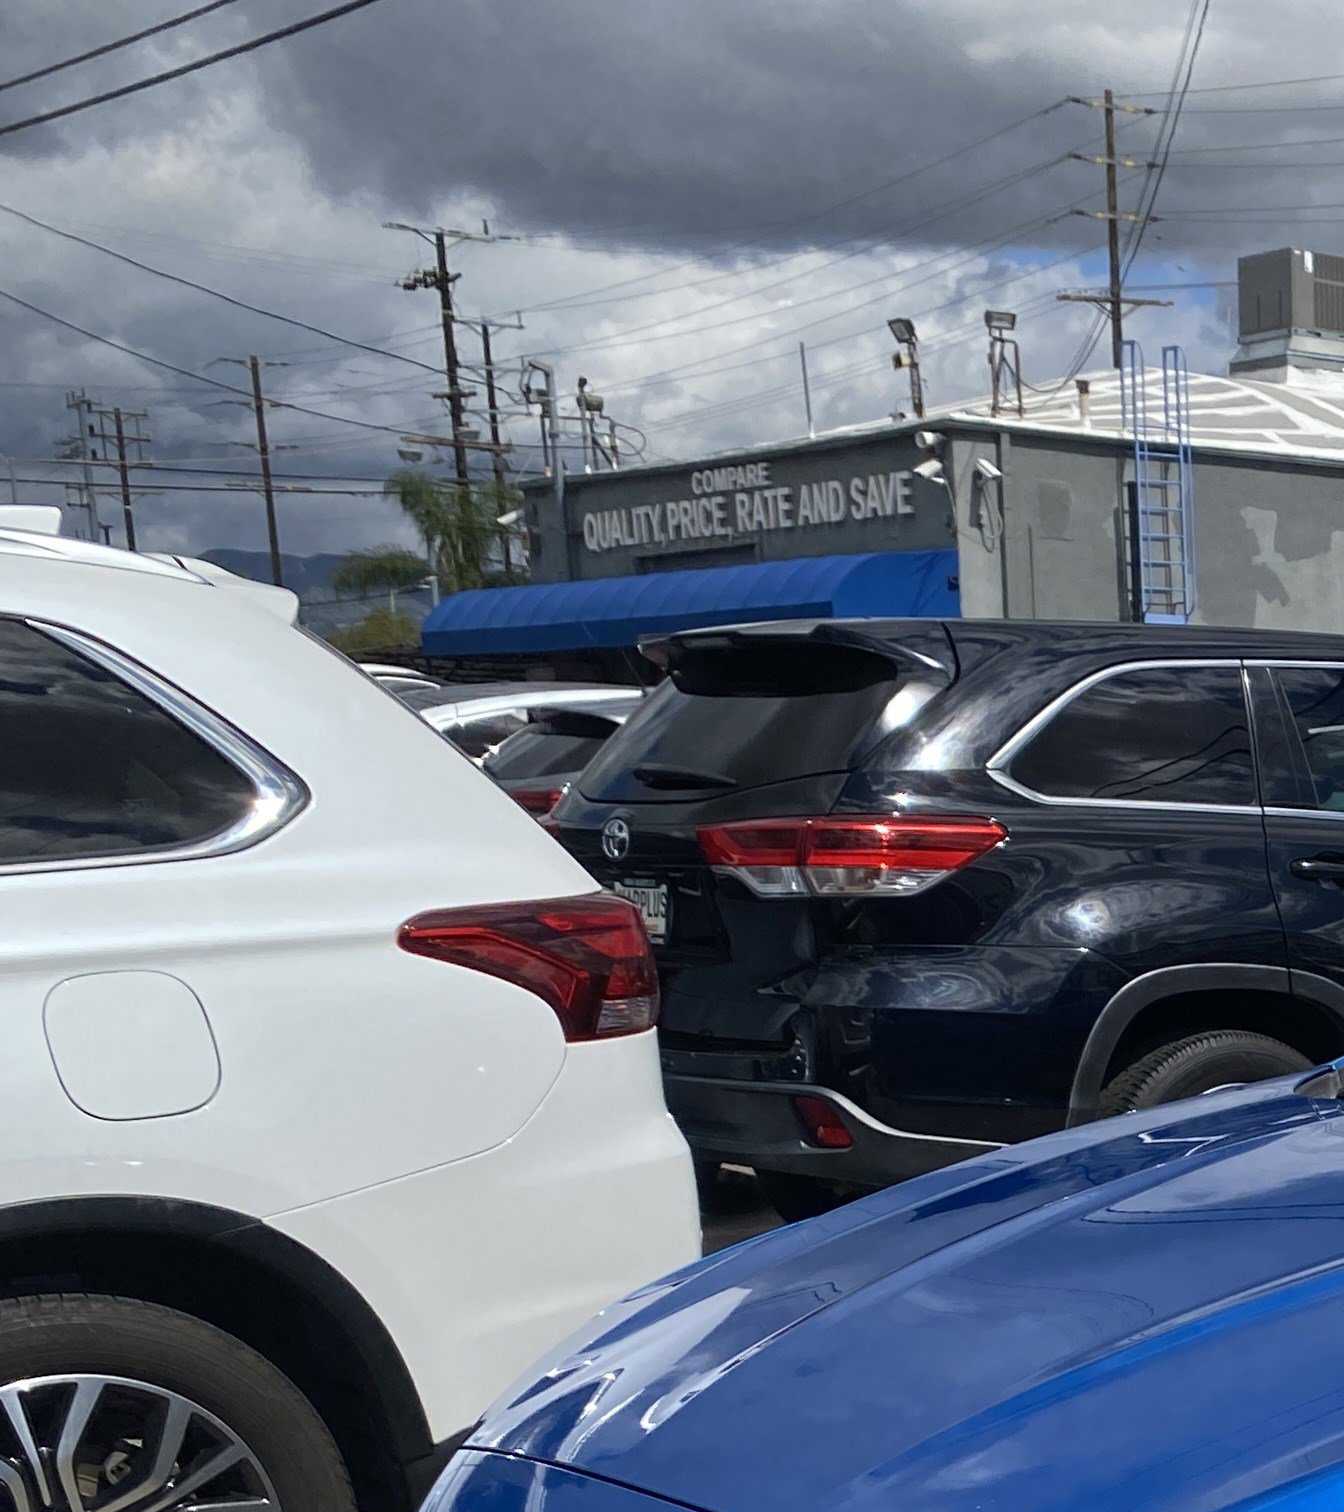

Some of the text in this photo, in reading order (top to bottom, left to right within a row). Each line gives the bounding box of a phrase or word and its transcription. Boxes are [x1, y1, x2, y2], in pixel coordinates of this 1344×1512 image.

[691, 462, 772, 494] COMPARE
[735, 487, 795, 532] RATE
[798, 480, 847, 526] AND
[850, 470, 916, 520] SAVE
